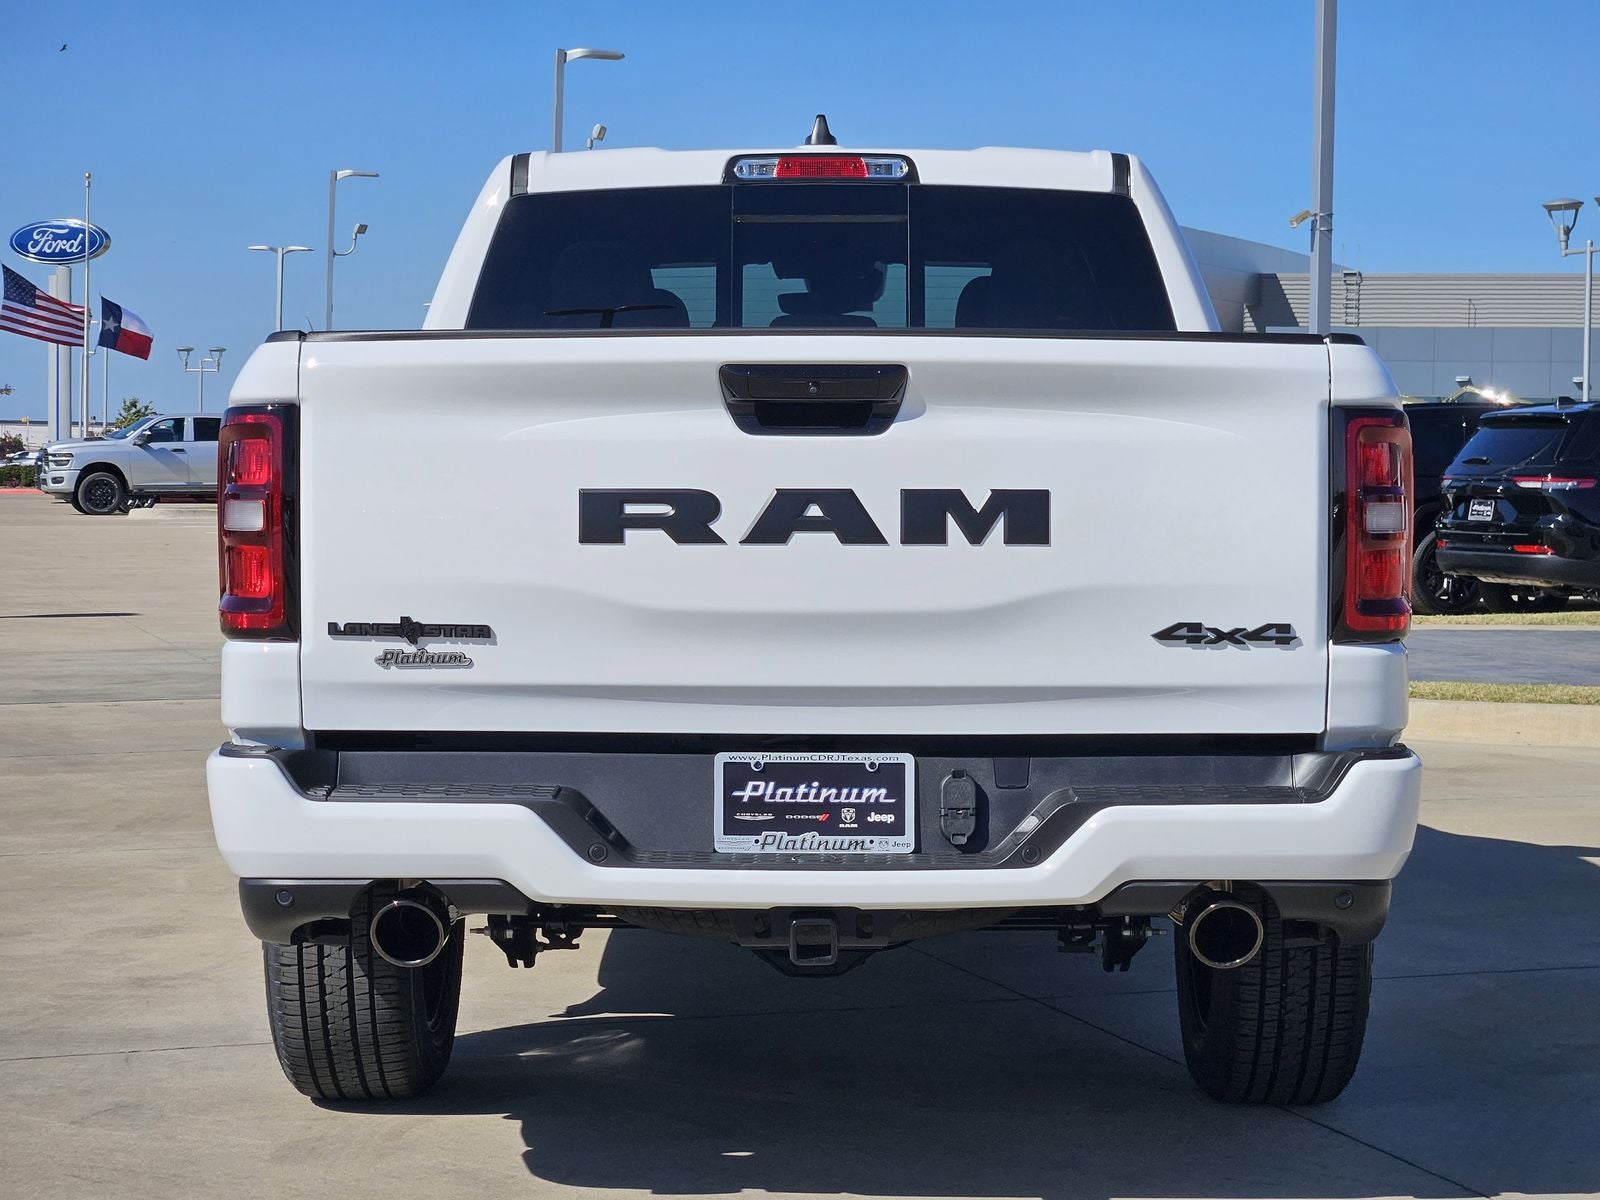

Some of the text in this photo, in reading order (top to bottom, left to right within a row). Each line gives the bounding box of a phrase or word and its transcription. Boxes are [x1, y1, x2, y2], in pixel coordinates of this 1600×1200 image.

[28, 228, 84, 253] Ford
[579, 488, 1050, 544] RAM
[328, 622, 492, 639] LONE STAR
[1151, 622, 1298, 645] 4x4
[375, 649, 473, 668] Platinum
[728, 754, 899, 762] www.PlatinumCDRJTexas.com
[732, 781, 896, 803] Platinum
[867, 811, 895, 824] Jeep
[760, 833, 875, 851] Platinum
